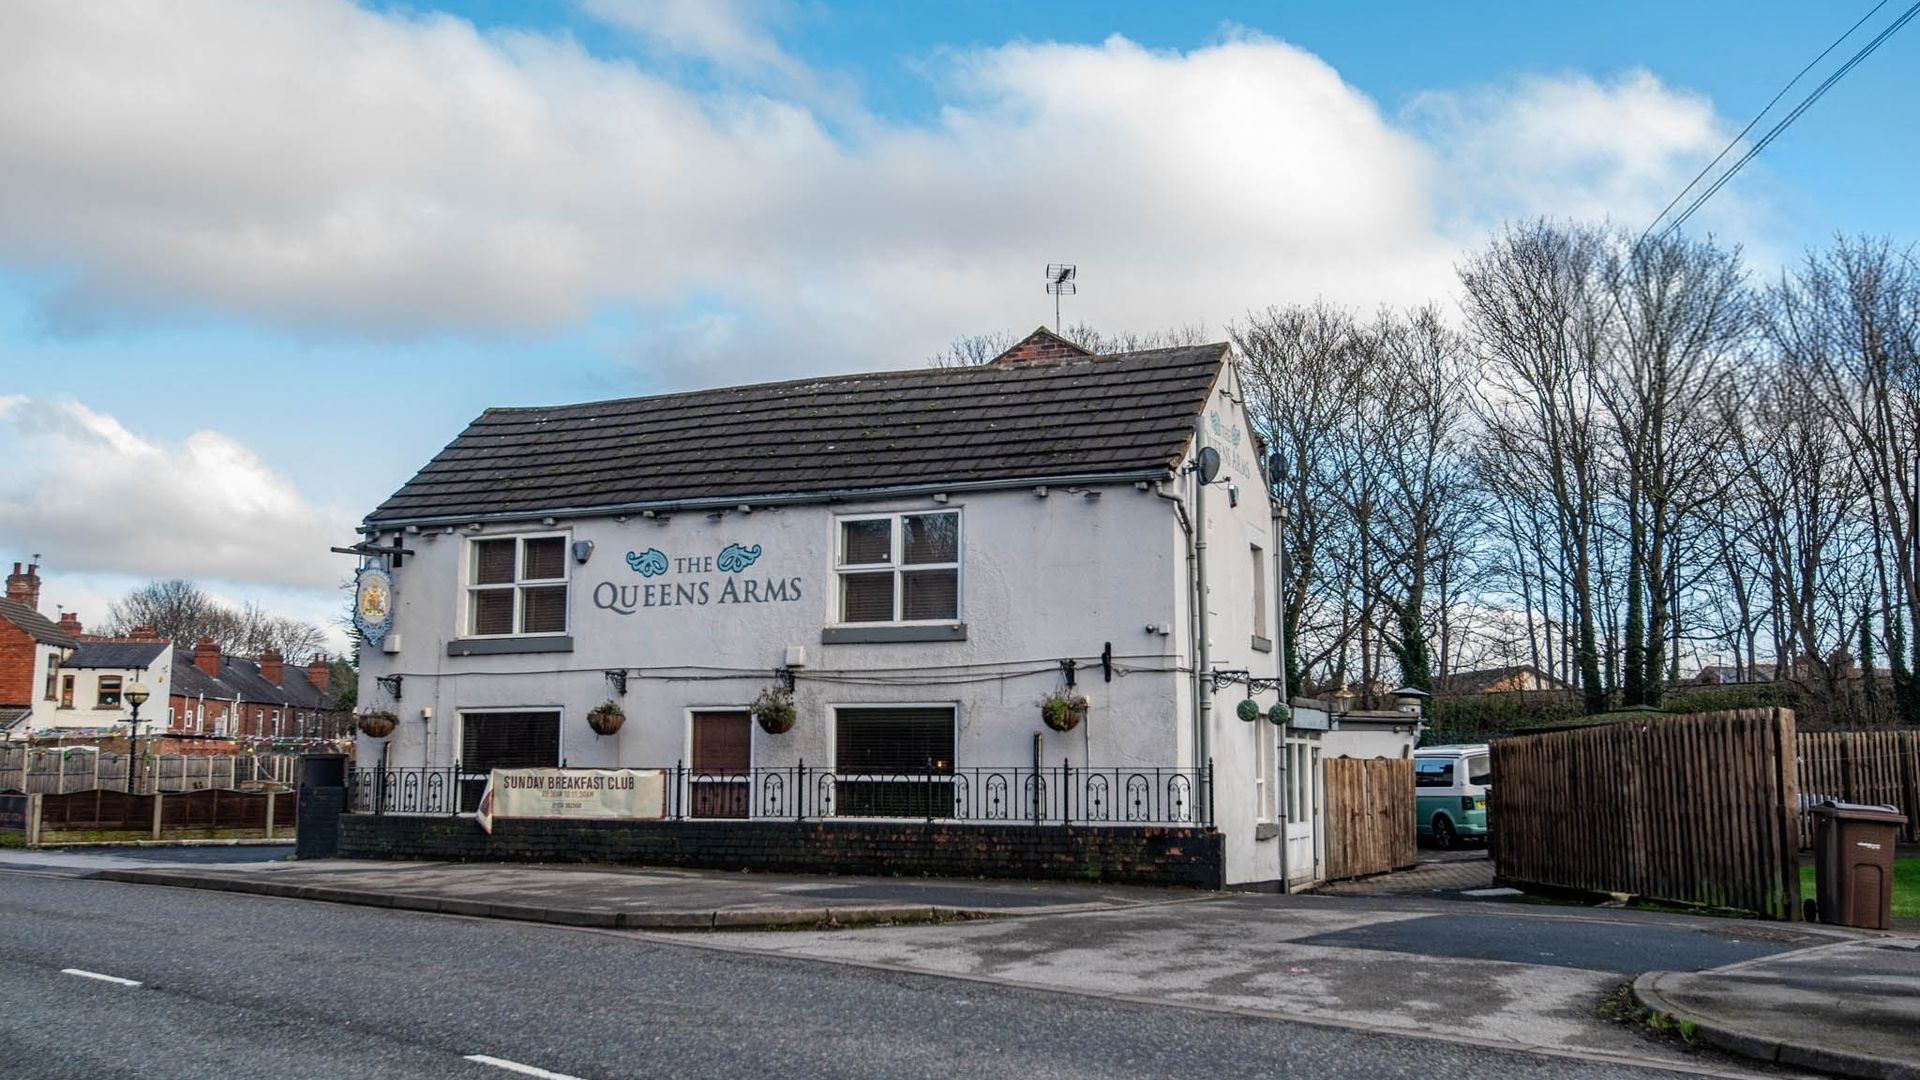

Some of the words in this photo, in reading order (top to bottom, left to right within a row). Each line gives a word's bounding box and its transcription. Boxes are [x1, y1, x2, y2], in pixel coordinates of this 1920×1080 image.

[674, 556, 713, 574] THE
[593, 581, 710, 615] QUEENS
[717, 576, 802, 604] ARMS
[503, 775, 545, 789] SUNDAY
[548, 776, 605, 790] BREAKFAST
[607, 776, 635, 790] CLUB
